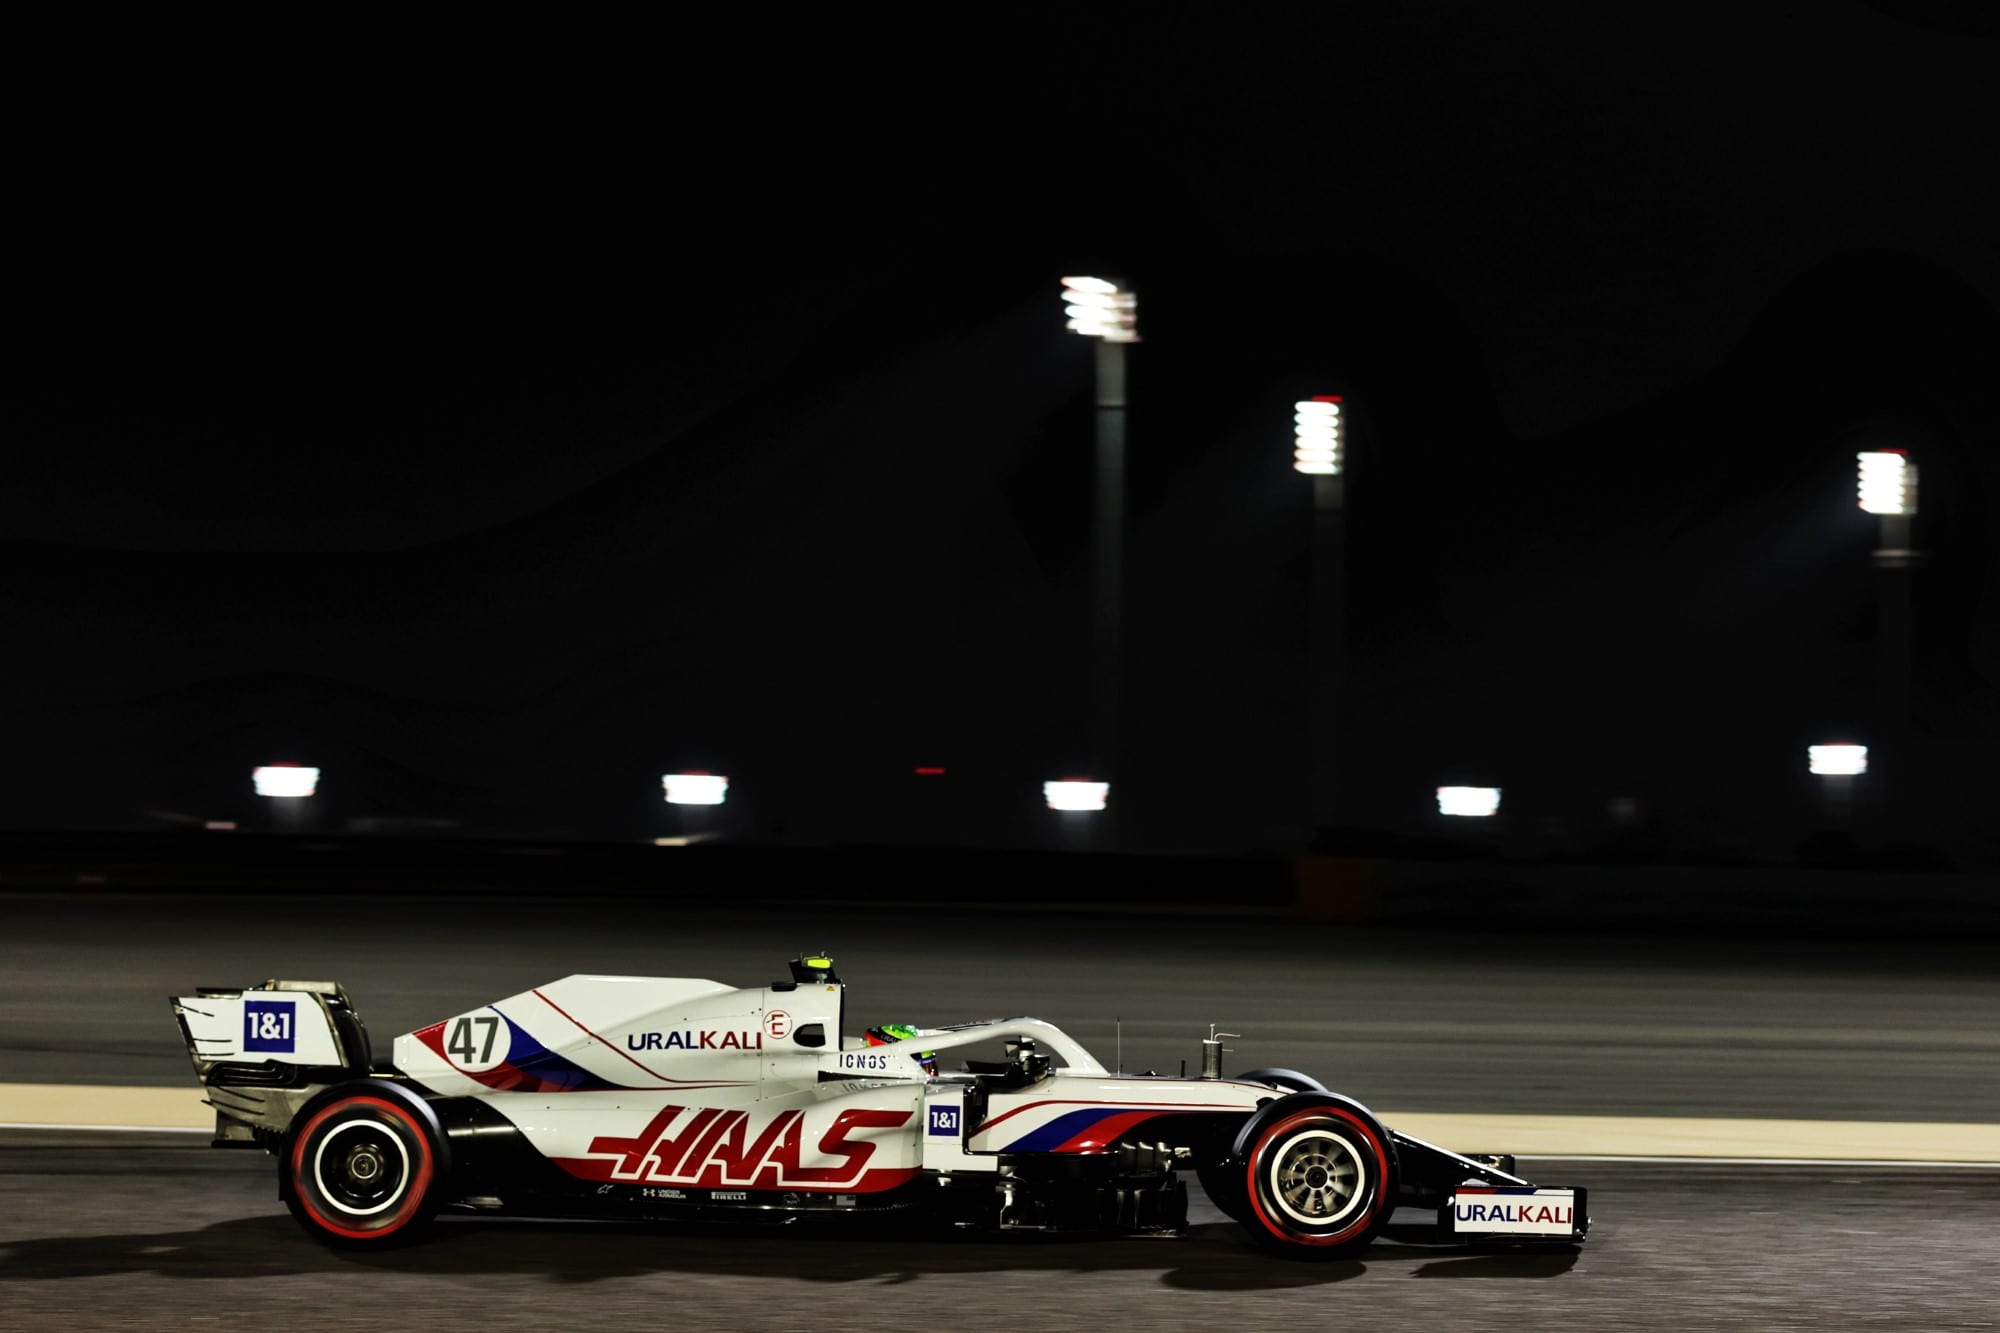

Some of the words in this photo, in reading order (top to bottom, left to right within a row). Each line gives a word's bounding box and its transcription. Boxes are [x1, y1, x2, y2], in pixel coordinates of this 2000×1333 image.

[248, 1012, 291, 1040] 1&1
[448, 1017, 499, 1064] 47
[628, 1031, 762, 1050] URALKALI
[931, 1112, 957, 1129] 1&1
[588, 1105, 914, 1188] HAAS
[1456, 1204, 1572, 1224] URALKALI
